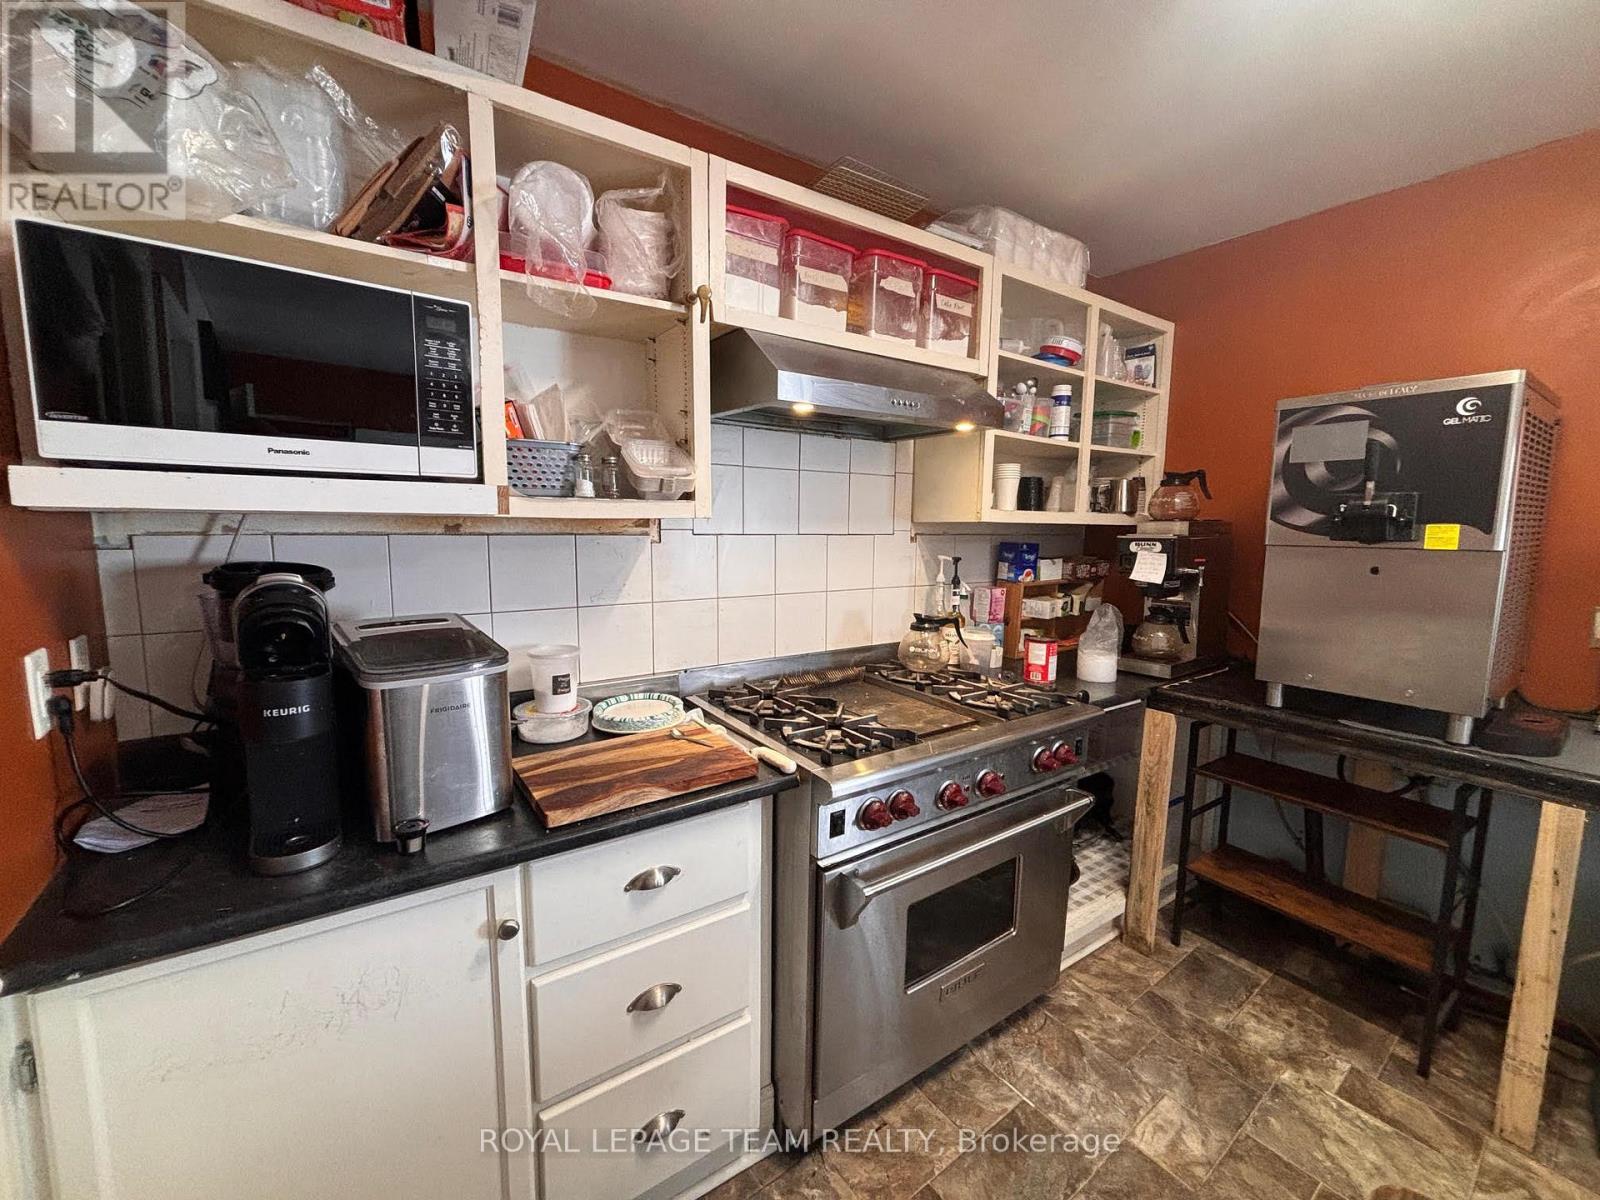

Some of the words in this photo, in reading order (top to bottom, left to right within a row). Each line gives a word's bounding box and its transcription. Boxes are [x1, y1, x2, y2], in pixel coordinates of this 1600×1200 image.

[1462, 415, 1491, 423] MATIC
[267, 447, 310, 456] Panasonic
[263, 704, 311, 717] KEURIG
